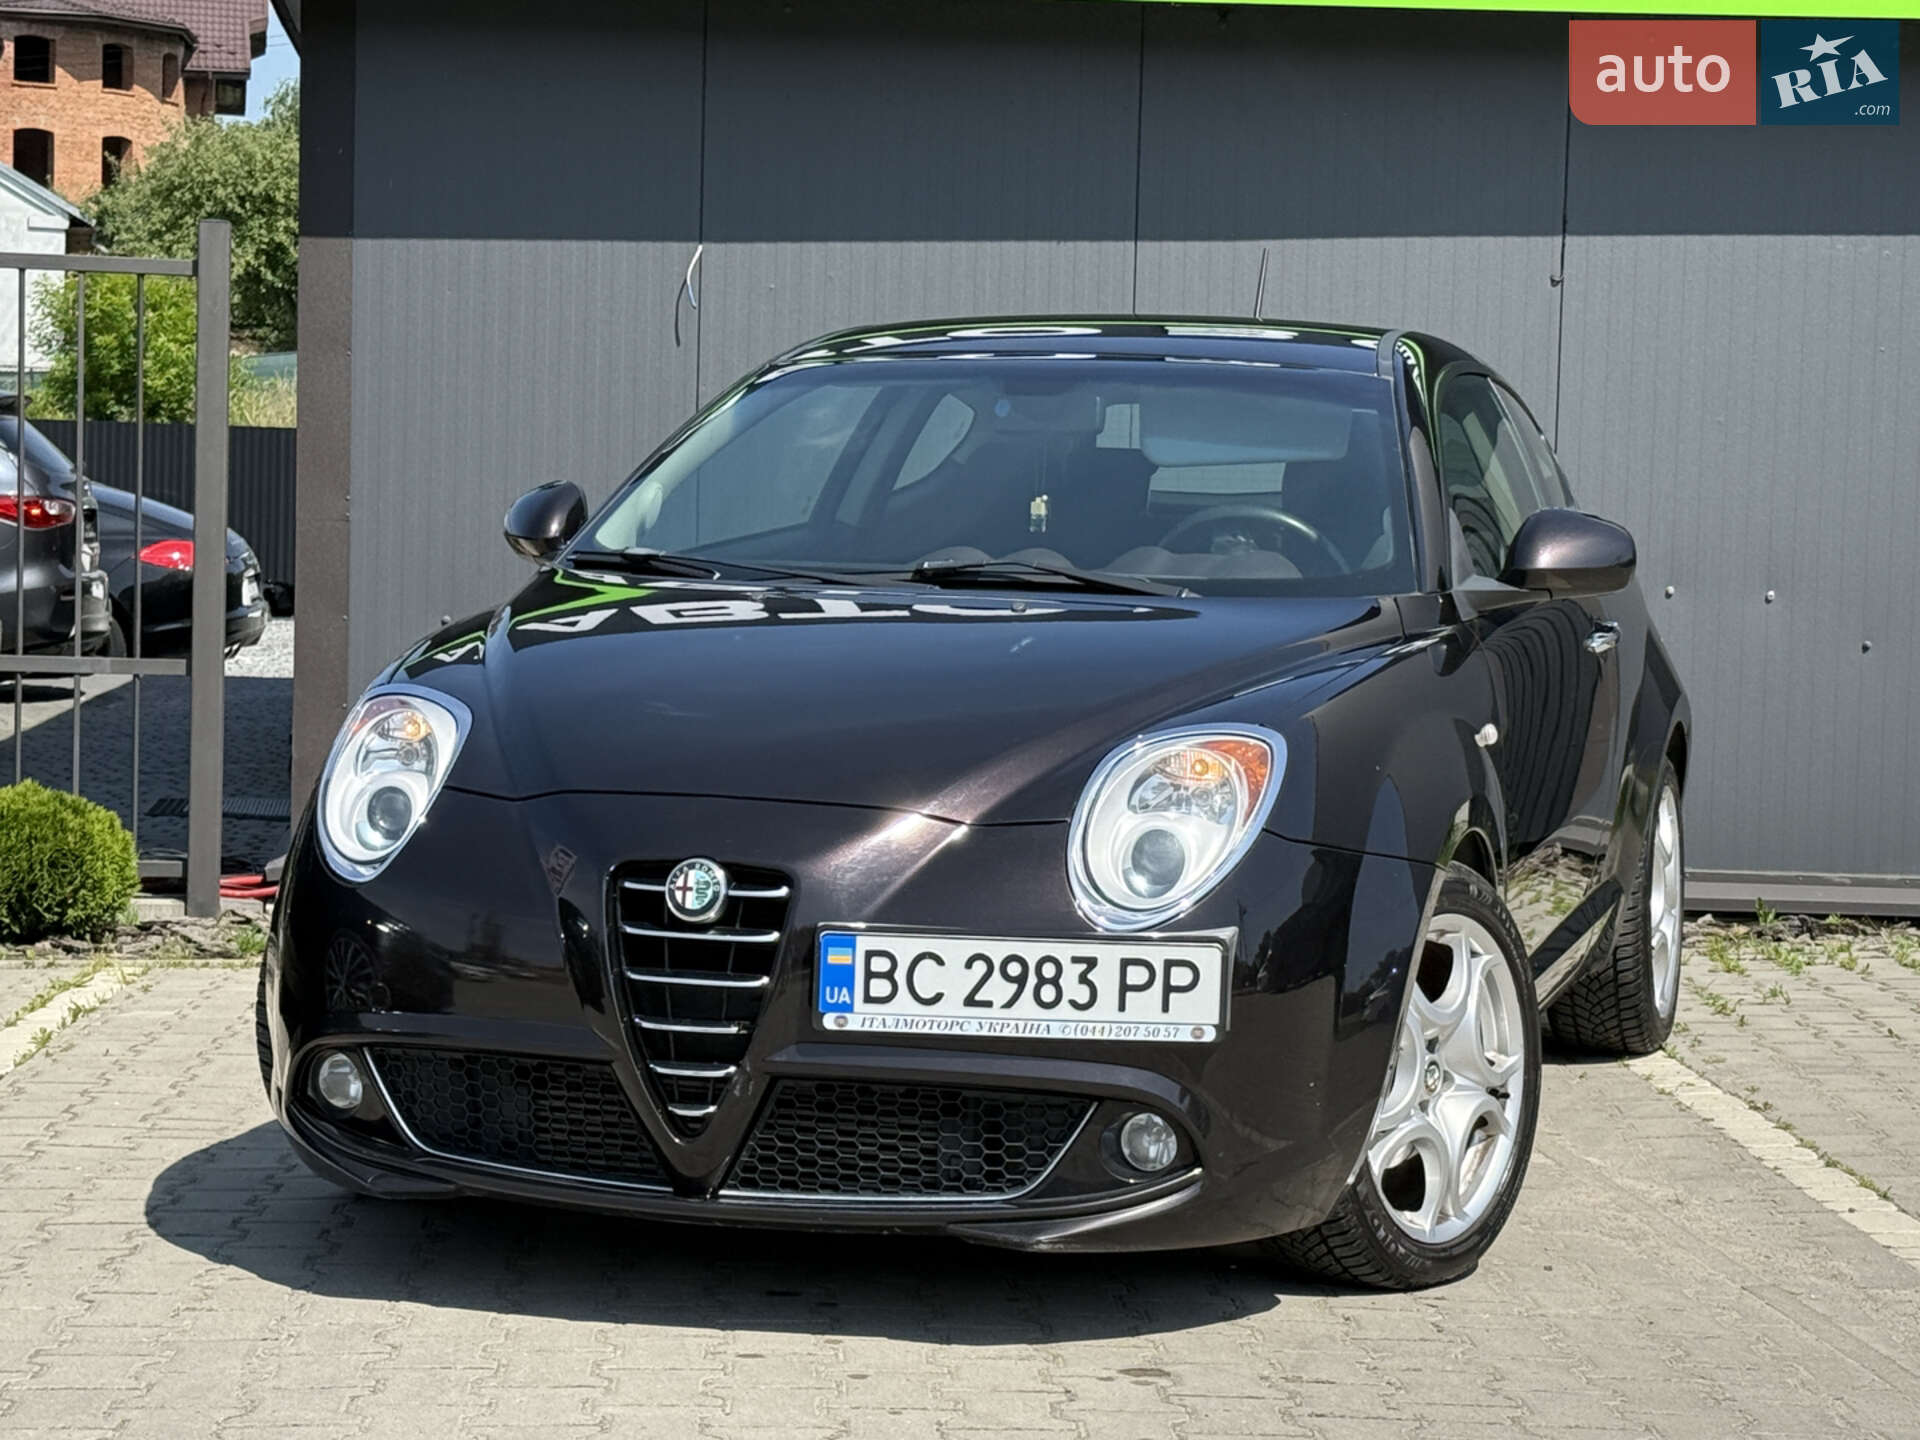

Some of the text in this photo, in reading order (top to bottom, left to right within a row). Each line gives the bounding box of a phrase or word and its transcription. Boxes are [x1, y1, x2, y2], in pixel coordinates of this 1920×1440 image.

[863, 949, 1201, 1014] BC 2983 PP
[825, 986, 851, 1004] UA
[976, 1020, 1051, 1036] УКРАЇНА
